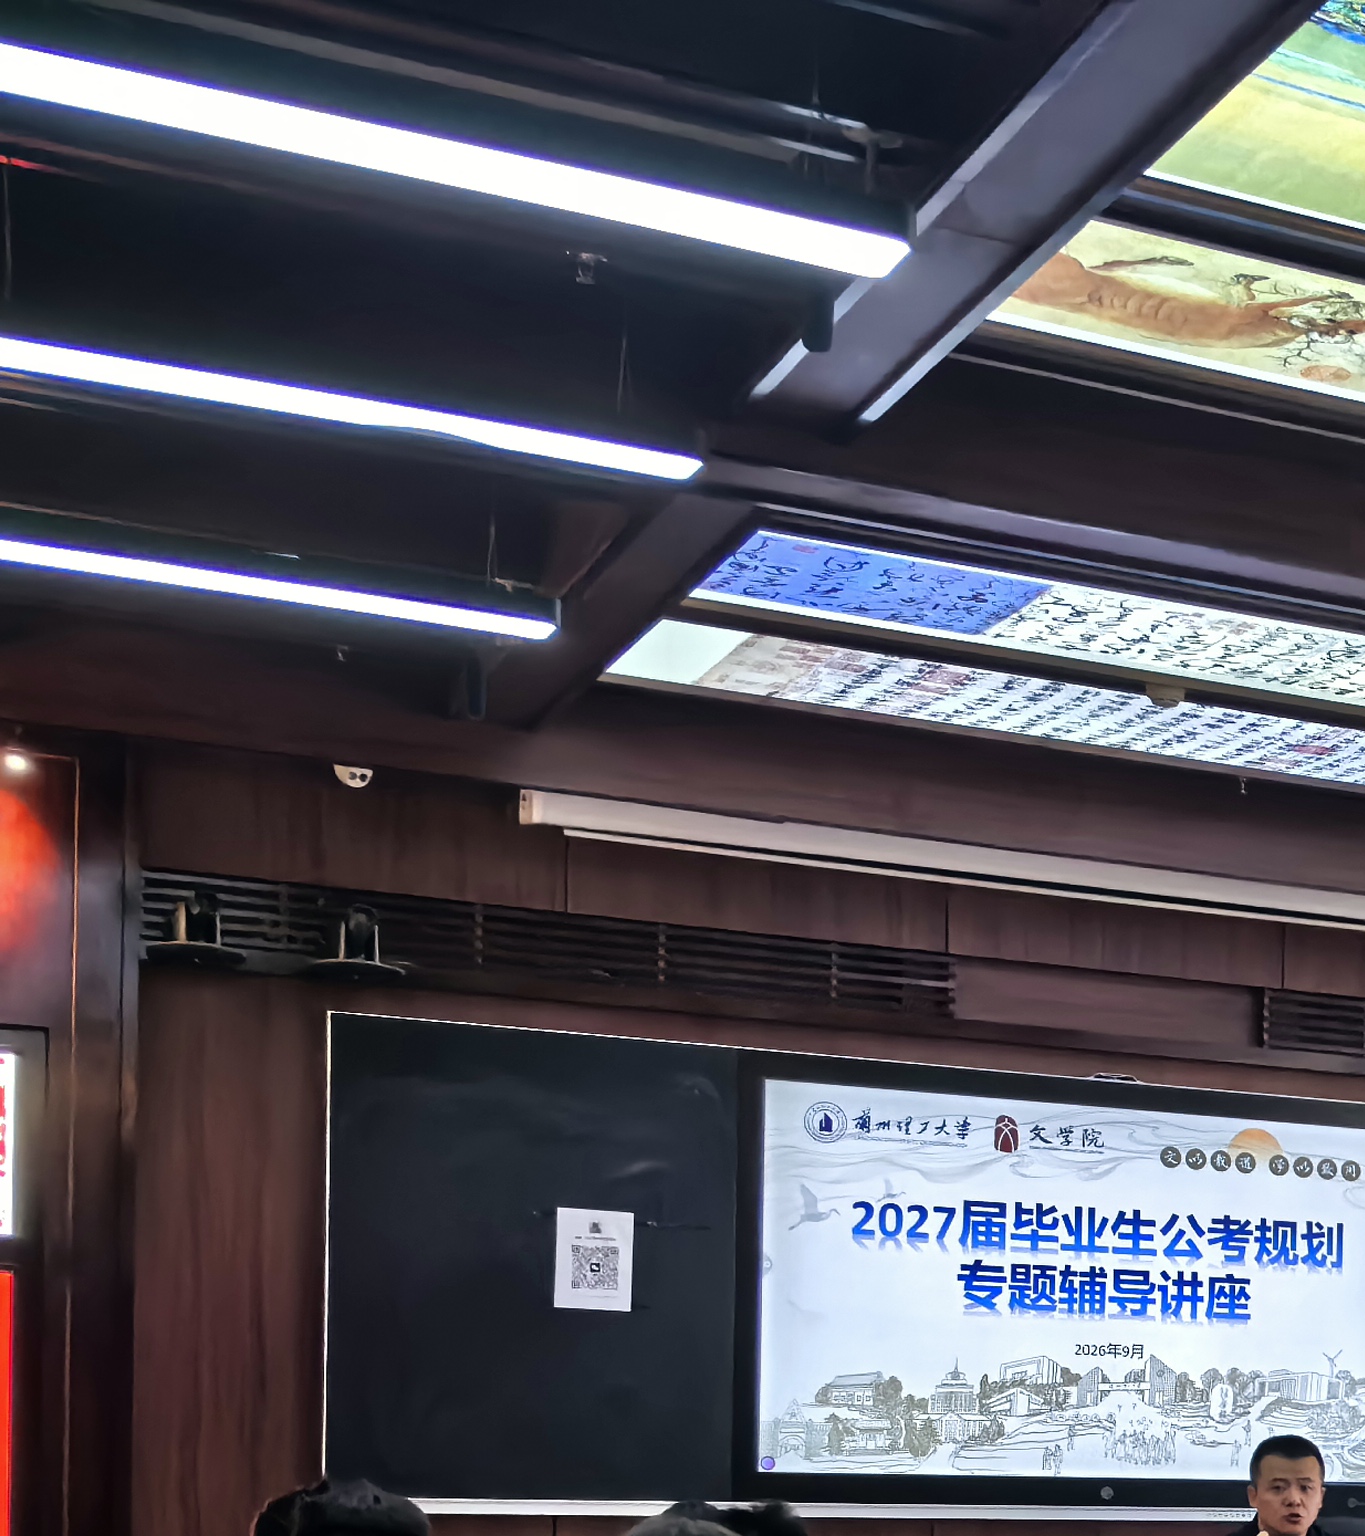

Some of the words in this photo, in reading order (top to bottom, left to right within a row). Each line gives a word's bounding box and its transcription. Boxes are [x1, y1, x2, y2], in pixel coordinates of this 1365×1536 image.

[851, 1200, 1344, 1269] 2027届毕业生公考规划
[957, 1260, 1251, 1320] 专题辅导讲座
[1074, 1343, 1144, 1359] 2026年9月
